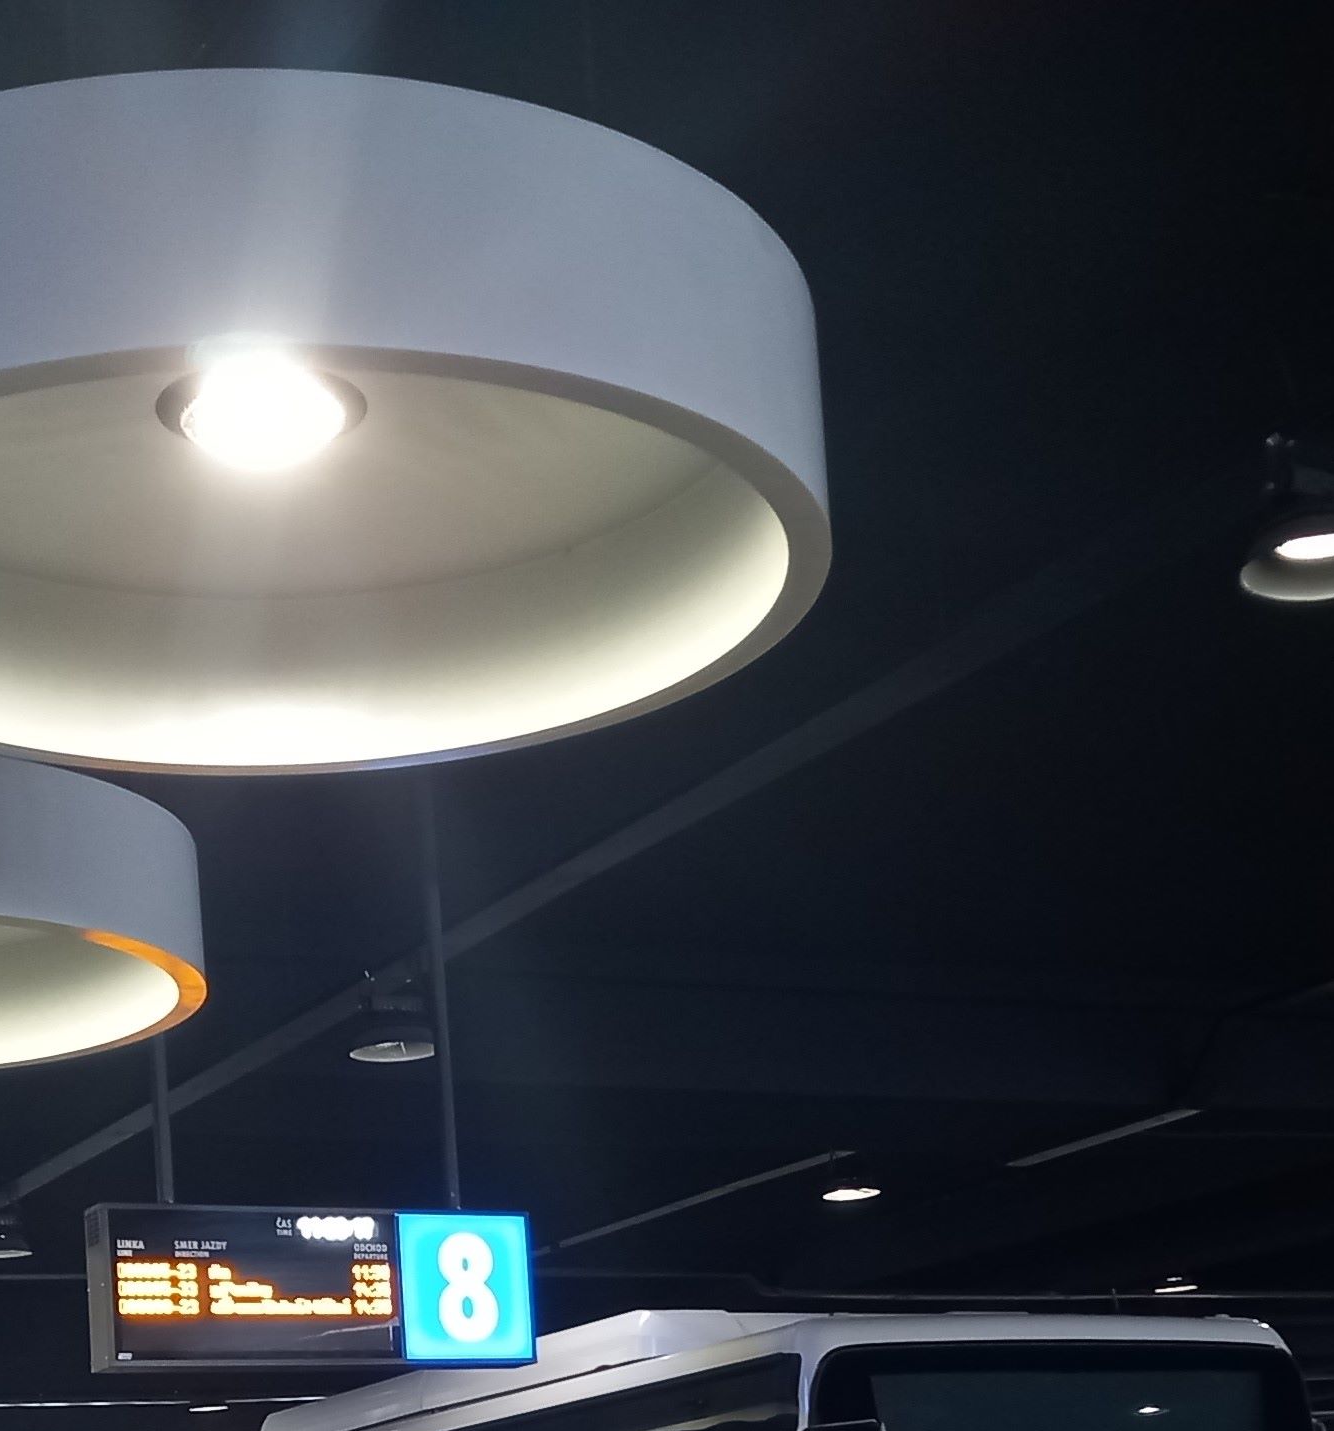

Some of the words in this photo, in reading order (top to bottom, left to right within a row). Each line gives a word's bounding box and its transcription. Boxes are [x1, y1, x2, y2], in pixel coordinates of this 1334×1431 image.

[116, 1239, 145, 1249] LINKA
[174, 1241, 199, 1249] SMER
[437, 1232, 499, 1342] 8
